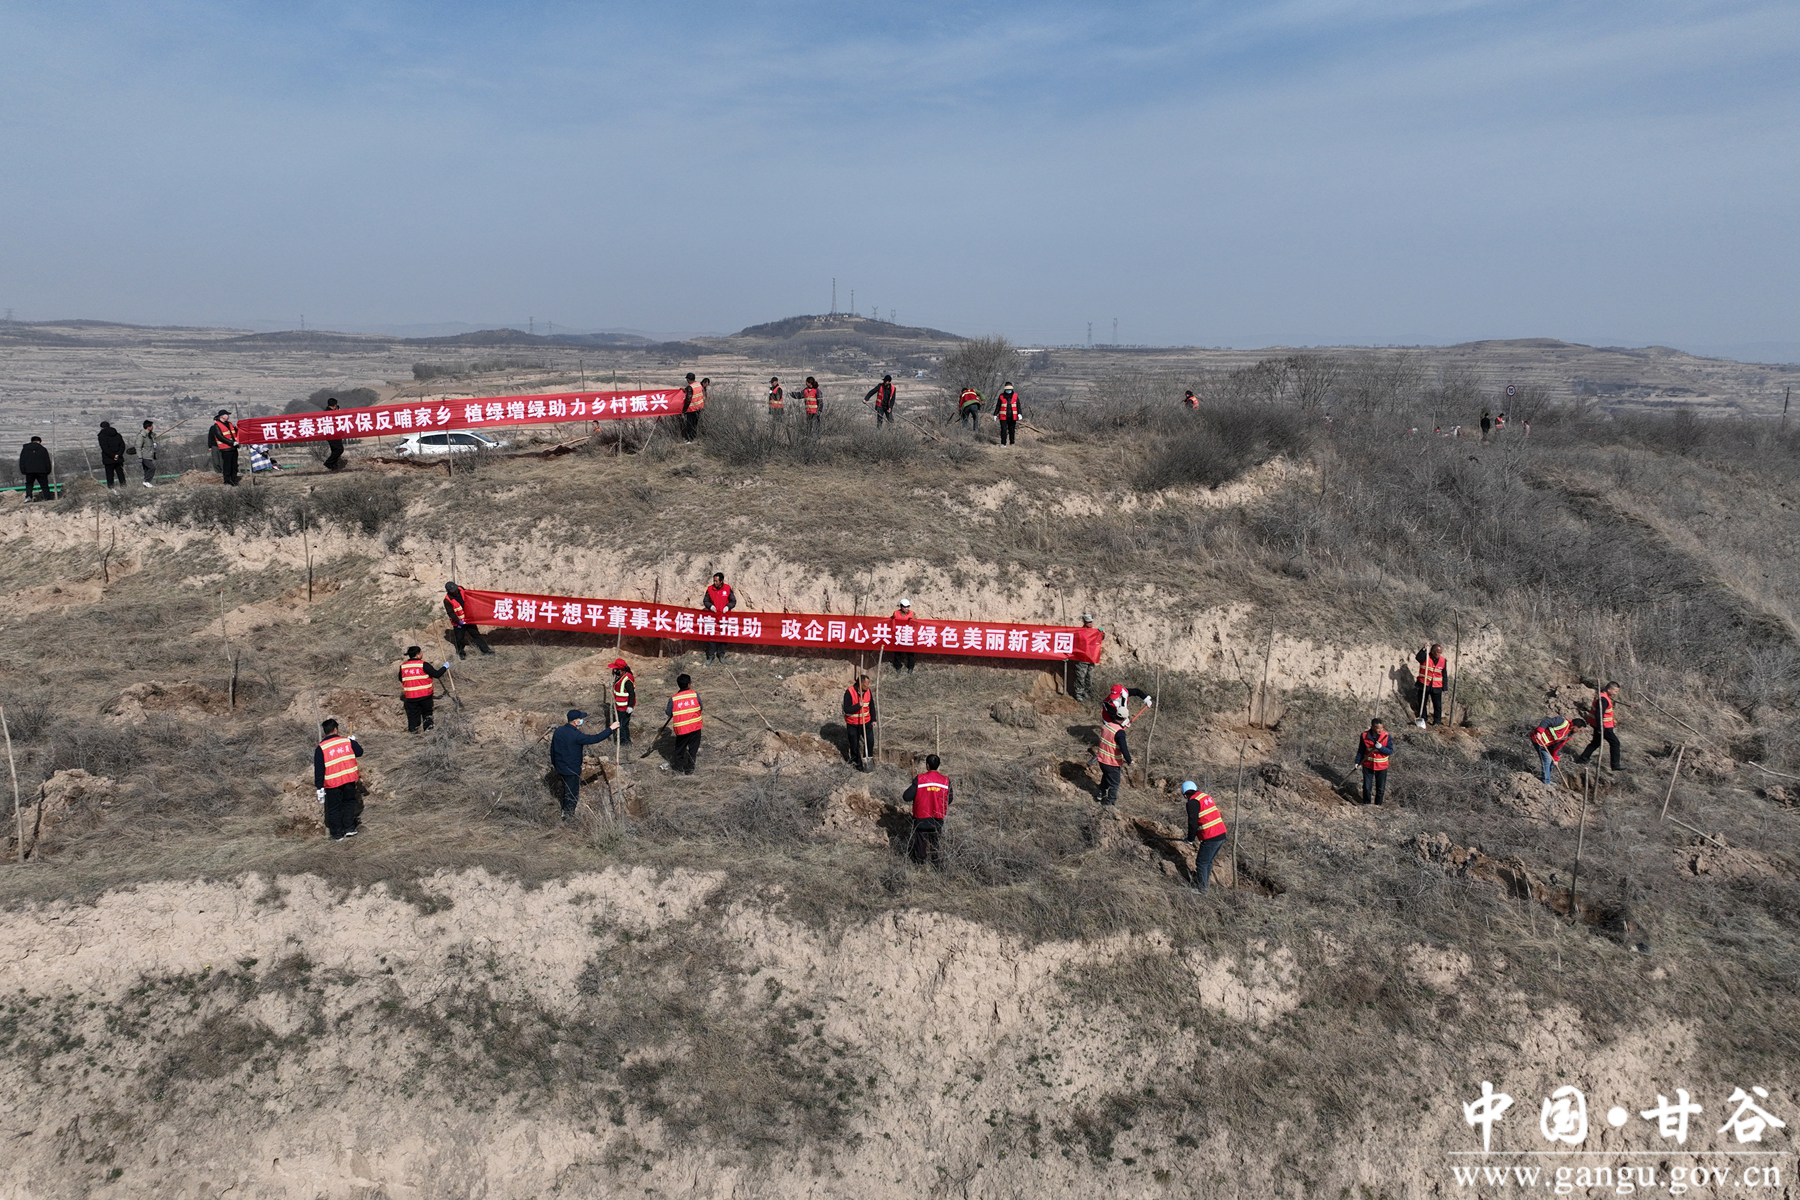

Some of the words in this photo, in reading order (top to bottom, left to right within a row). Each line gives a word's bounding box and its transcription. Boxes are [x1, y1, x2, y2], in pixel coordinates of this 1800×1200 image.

[260, 405, 451, 441] 西安泰瑞环保反哺家乡
[464, 393, 669, 423] 植绿增绿助力乡村振兴
[493, 598, 763, 638] 感谢牛想平董事长倾情捐助
[781, 618, 1075, 654] 政企同心共建绿色美丽新家园
